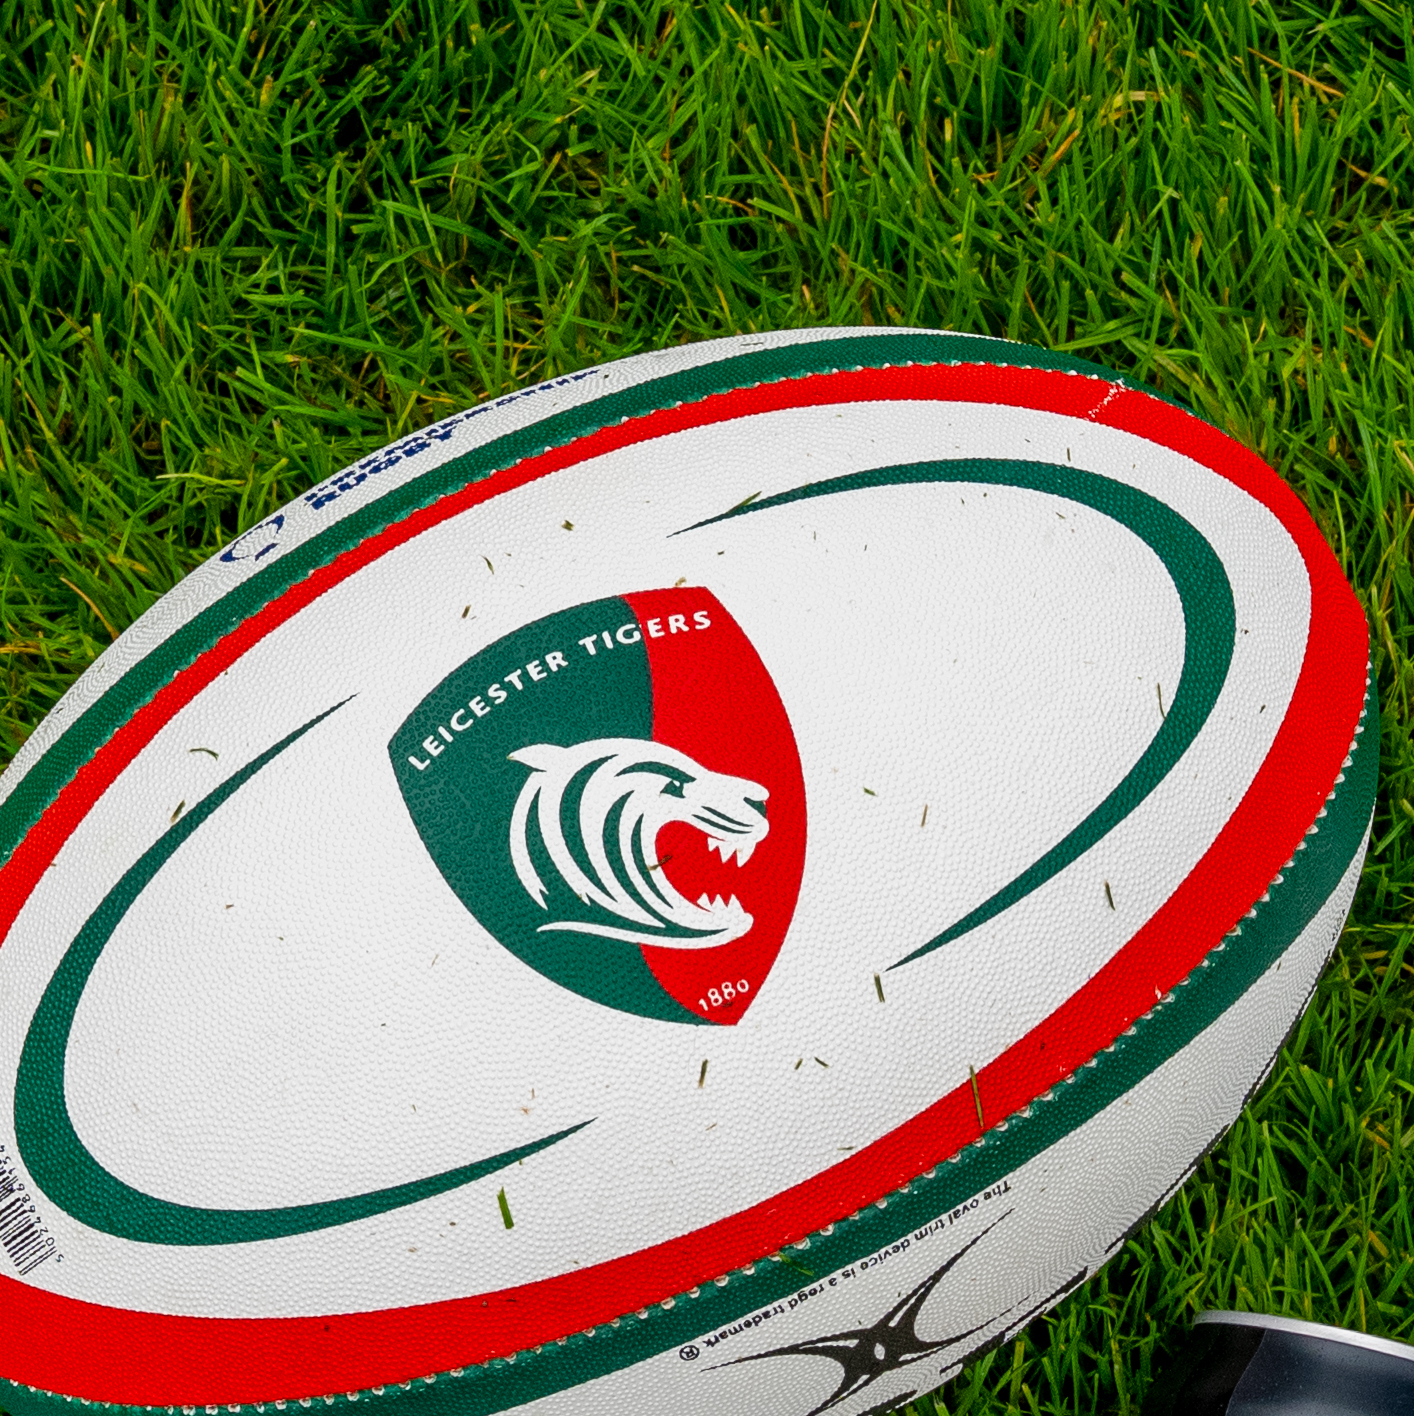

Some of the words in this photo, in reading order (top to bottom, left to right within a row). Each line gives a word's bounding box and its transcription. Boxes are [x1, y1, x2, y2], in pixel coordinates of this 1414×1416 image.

[408, 650, 569, 771] LEICESTER
[578, 610, 712, 656] TIGERS
[698, 978, 749, 1012] 1880
[983, 1180, 1012, 1201] The
[948, 1197, 979, 1224] oval
[914, 1215, 945, 1242] trim
[860, 1236, 911, 1272] device
[828, 1276, 838, 1287] a
[841, 1264, 858, 1280] is
[788, 1283, 825, 1309] regd
[703, 1303, 785, 1348] trademark
